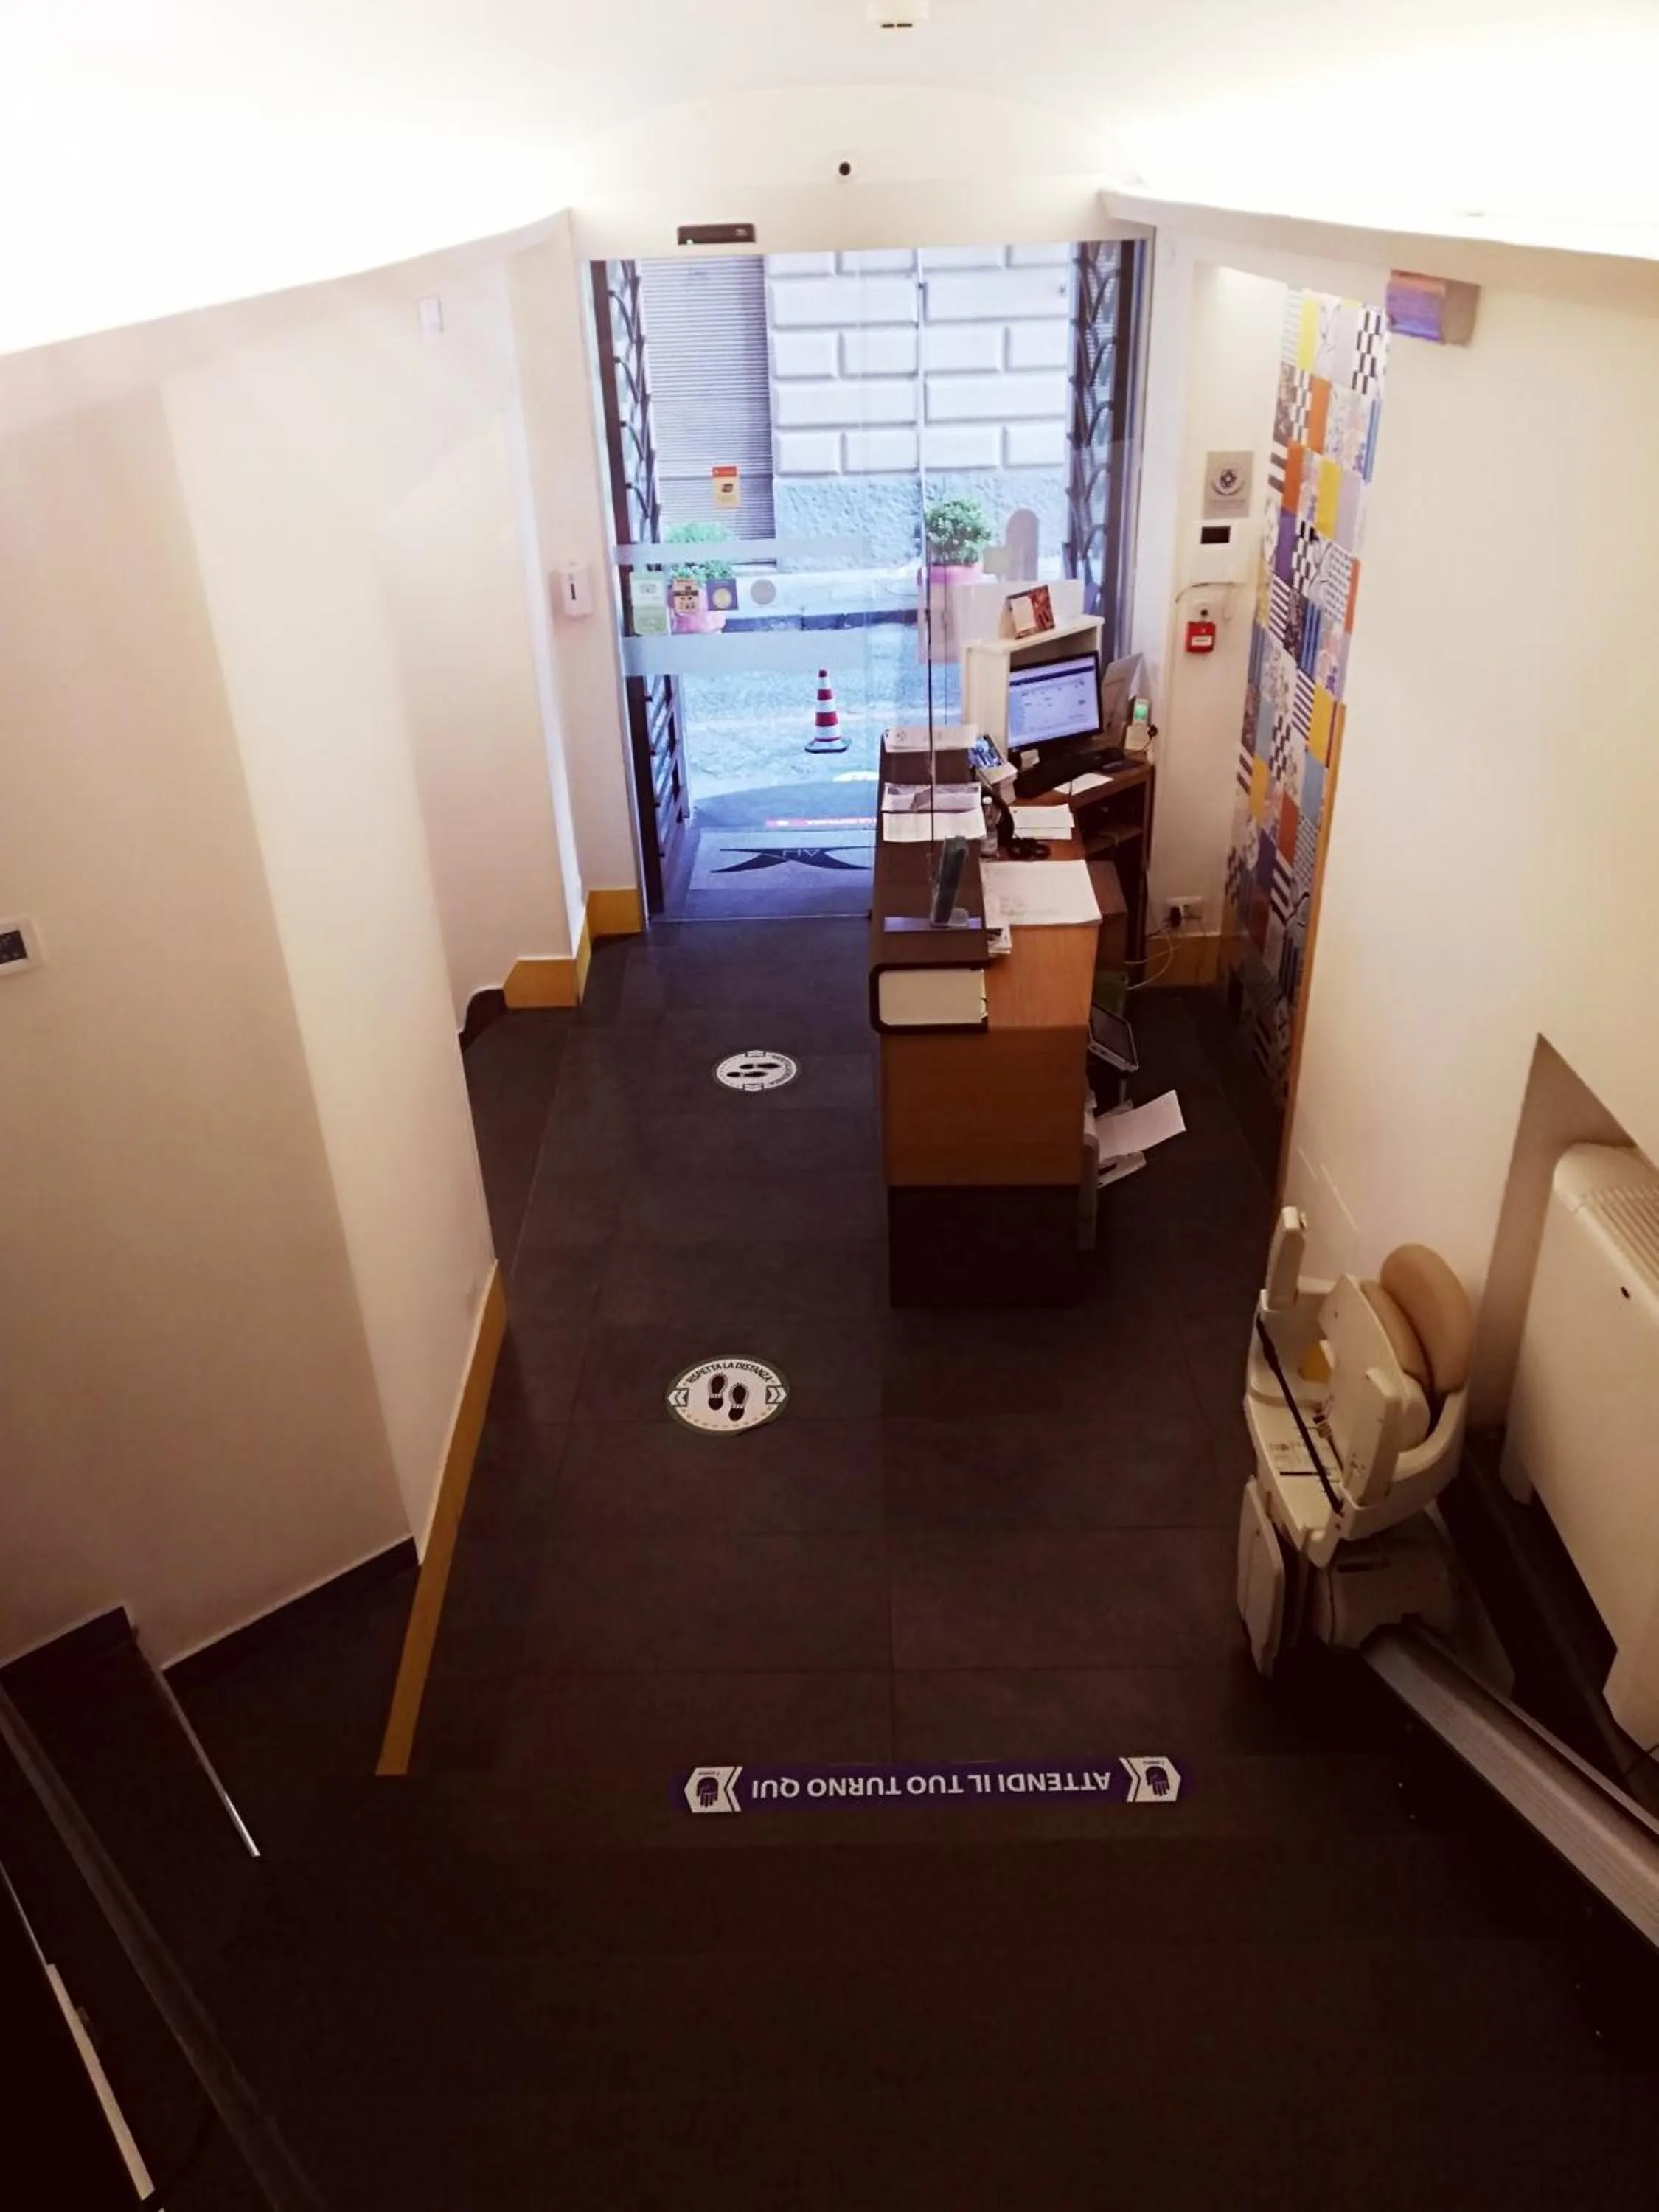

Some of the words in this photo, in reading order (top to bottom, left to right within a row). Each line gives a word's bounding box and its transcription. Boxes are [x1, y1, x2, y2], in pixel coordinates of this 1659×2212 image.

[685, 1363, 723, 1384] RISPETTA
[723, 1361, 734, 1369] LA
[735, 1362, 773, 1382] DISTANZA
[751, 1777, 800, 1798] QUI
[807, 1776, 902, 1797] TURNO
[906, 1775, 964, 1795] TUO
[967, 1774, 991, 1792] IL
[998, 1772, 1112, 1792] ATTENDI
